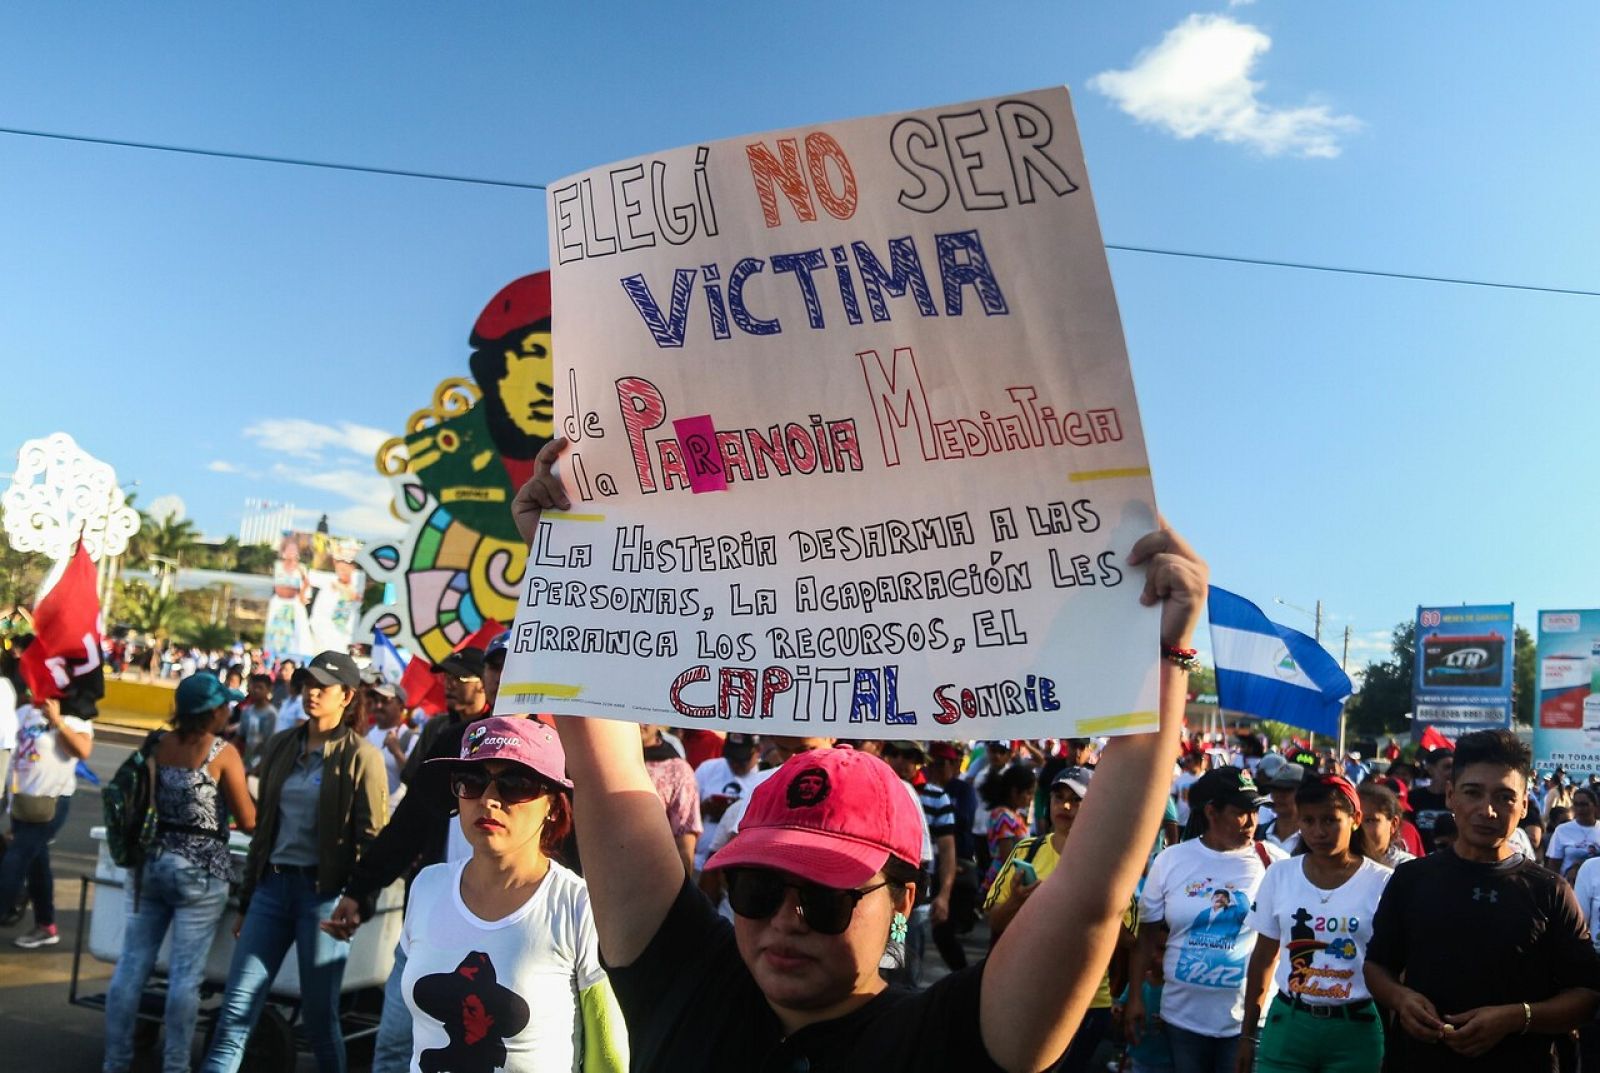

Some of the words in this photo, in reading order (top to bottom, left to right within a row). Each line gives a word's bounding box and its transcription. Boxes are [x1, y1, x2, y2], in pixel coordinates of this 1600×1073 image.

[745, 131, 858, 228] NO
[890, 100, 1078, 213] SER
[563, 367, 605, 443] de
[571, 453, 619, 501] la
[789, 511, 975, 562] DESARMA
[990, 507, 1018, 543] A
[1026, 499, 1101, 537] LAS
[526, 576, 714, 621] PERSONAS,
[1048, 548, 1123, 589] LES
[513, 620, 678, 658] ARRANCA
[696, 631, 757, 662] LOS
[766, 617, 967, 660] RECURSOS,
[972, 608, 1028, 649] EL
[1421, 611, 1441, 627] 60
[1315, 916, 1359, 933] 2019
[1186, 961, 1241, 986] PAZ
